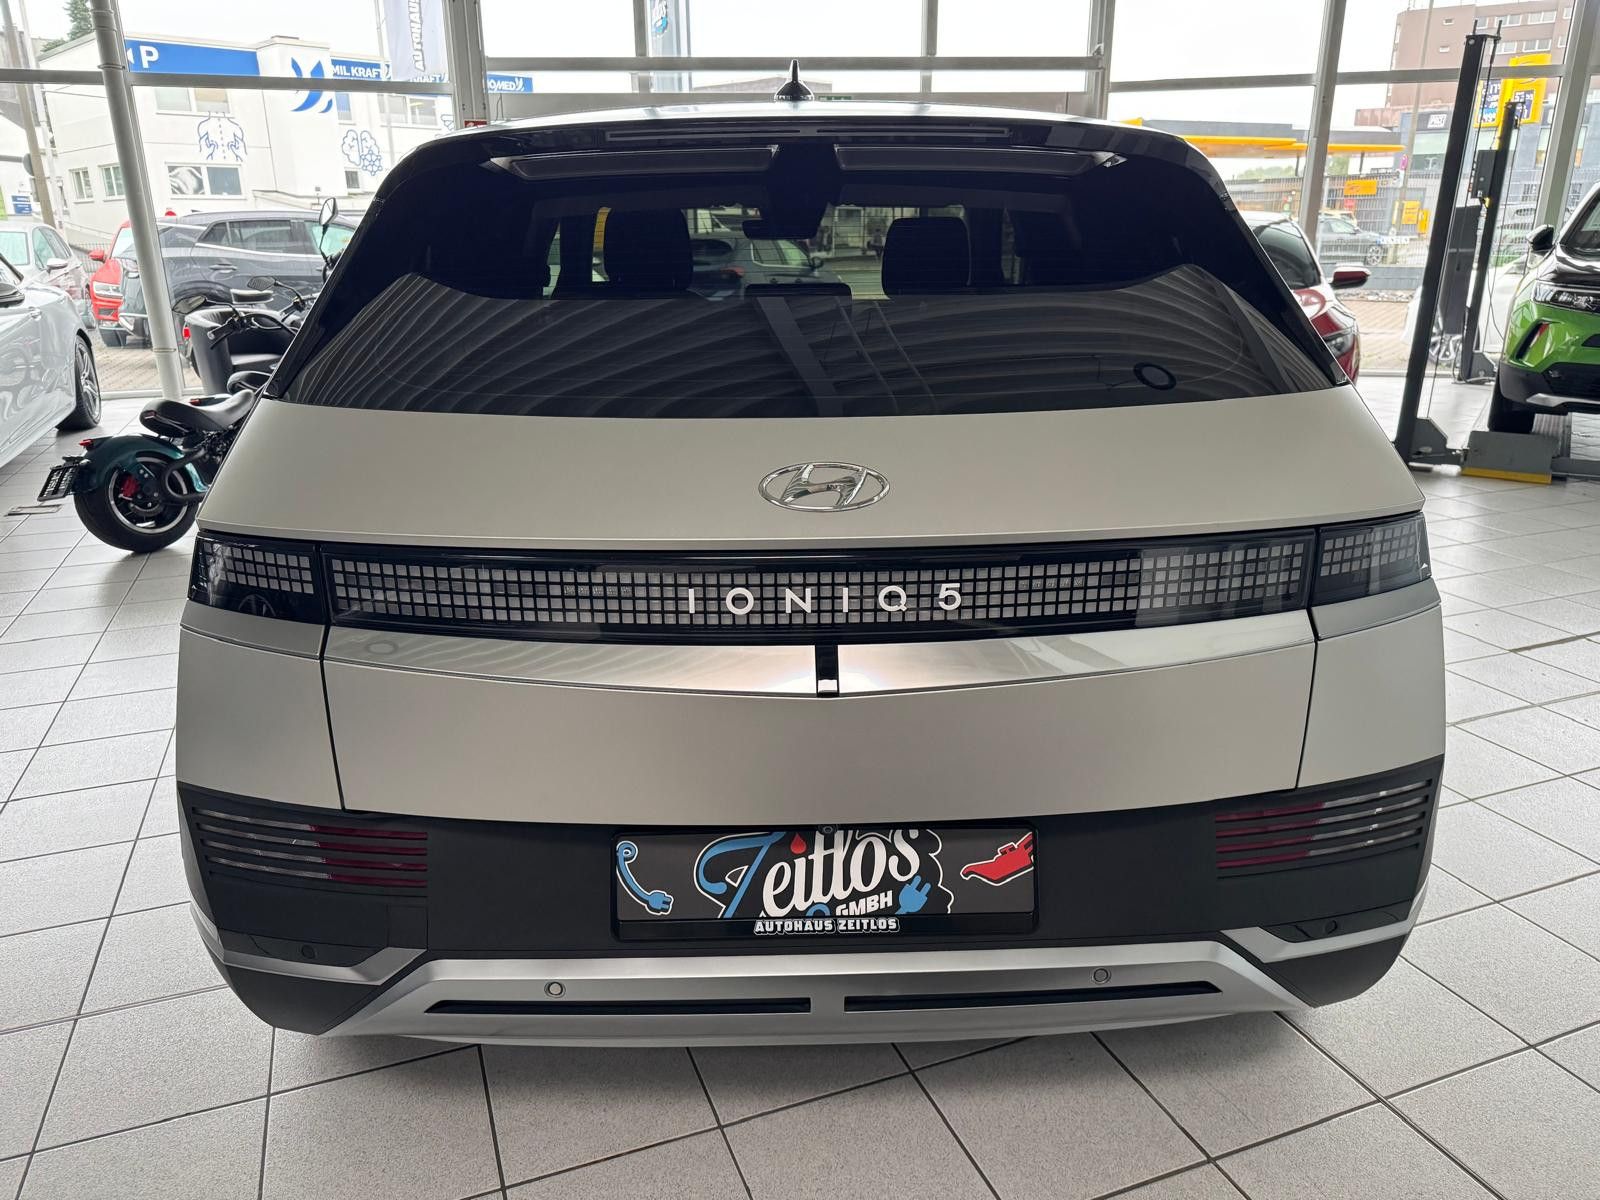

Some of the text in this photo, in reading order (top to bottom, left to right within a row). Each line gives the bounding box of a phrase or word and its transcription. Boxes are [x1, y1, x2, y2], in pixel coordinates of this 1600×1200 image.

[408, 0, 425, 72] AUTOHAU
[139, 45, 159, 69] P
[351, 67, 381, 78] KRAFT
[688, 583, 962, 615] IONIQ 5
[835, 890, 893, 916] GMBH
[754, 918, 899, 934] AUTOHAUS ZEITLOS
